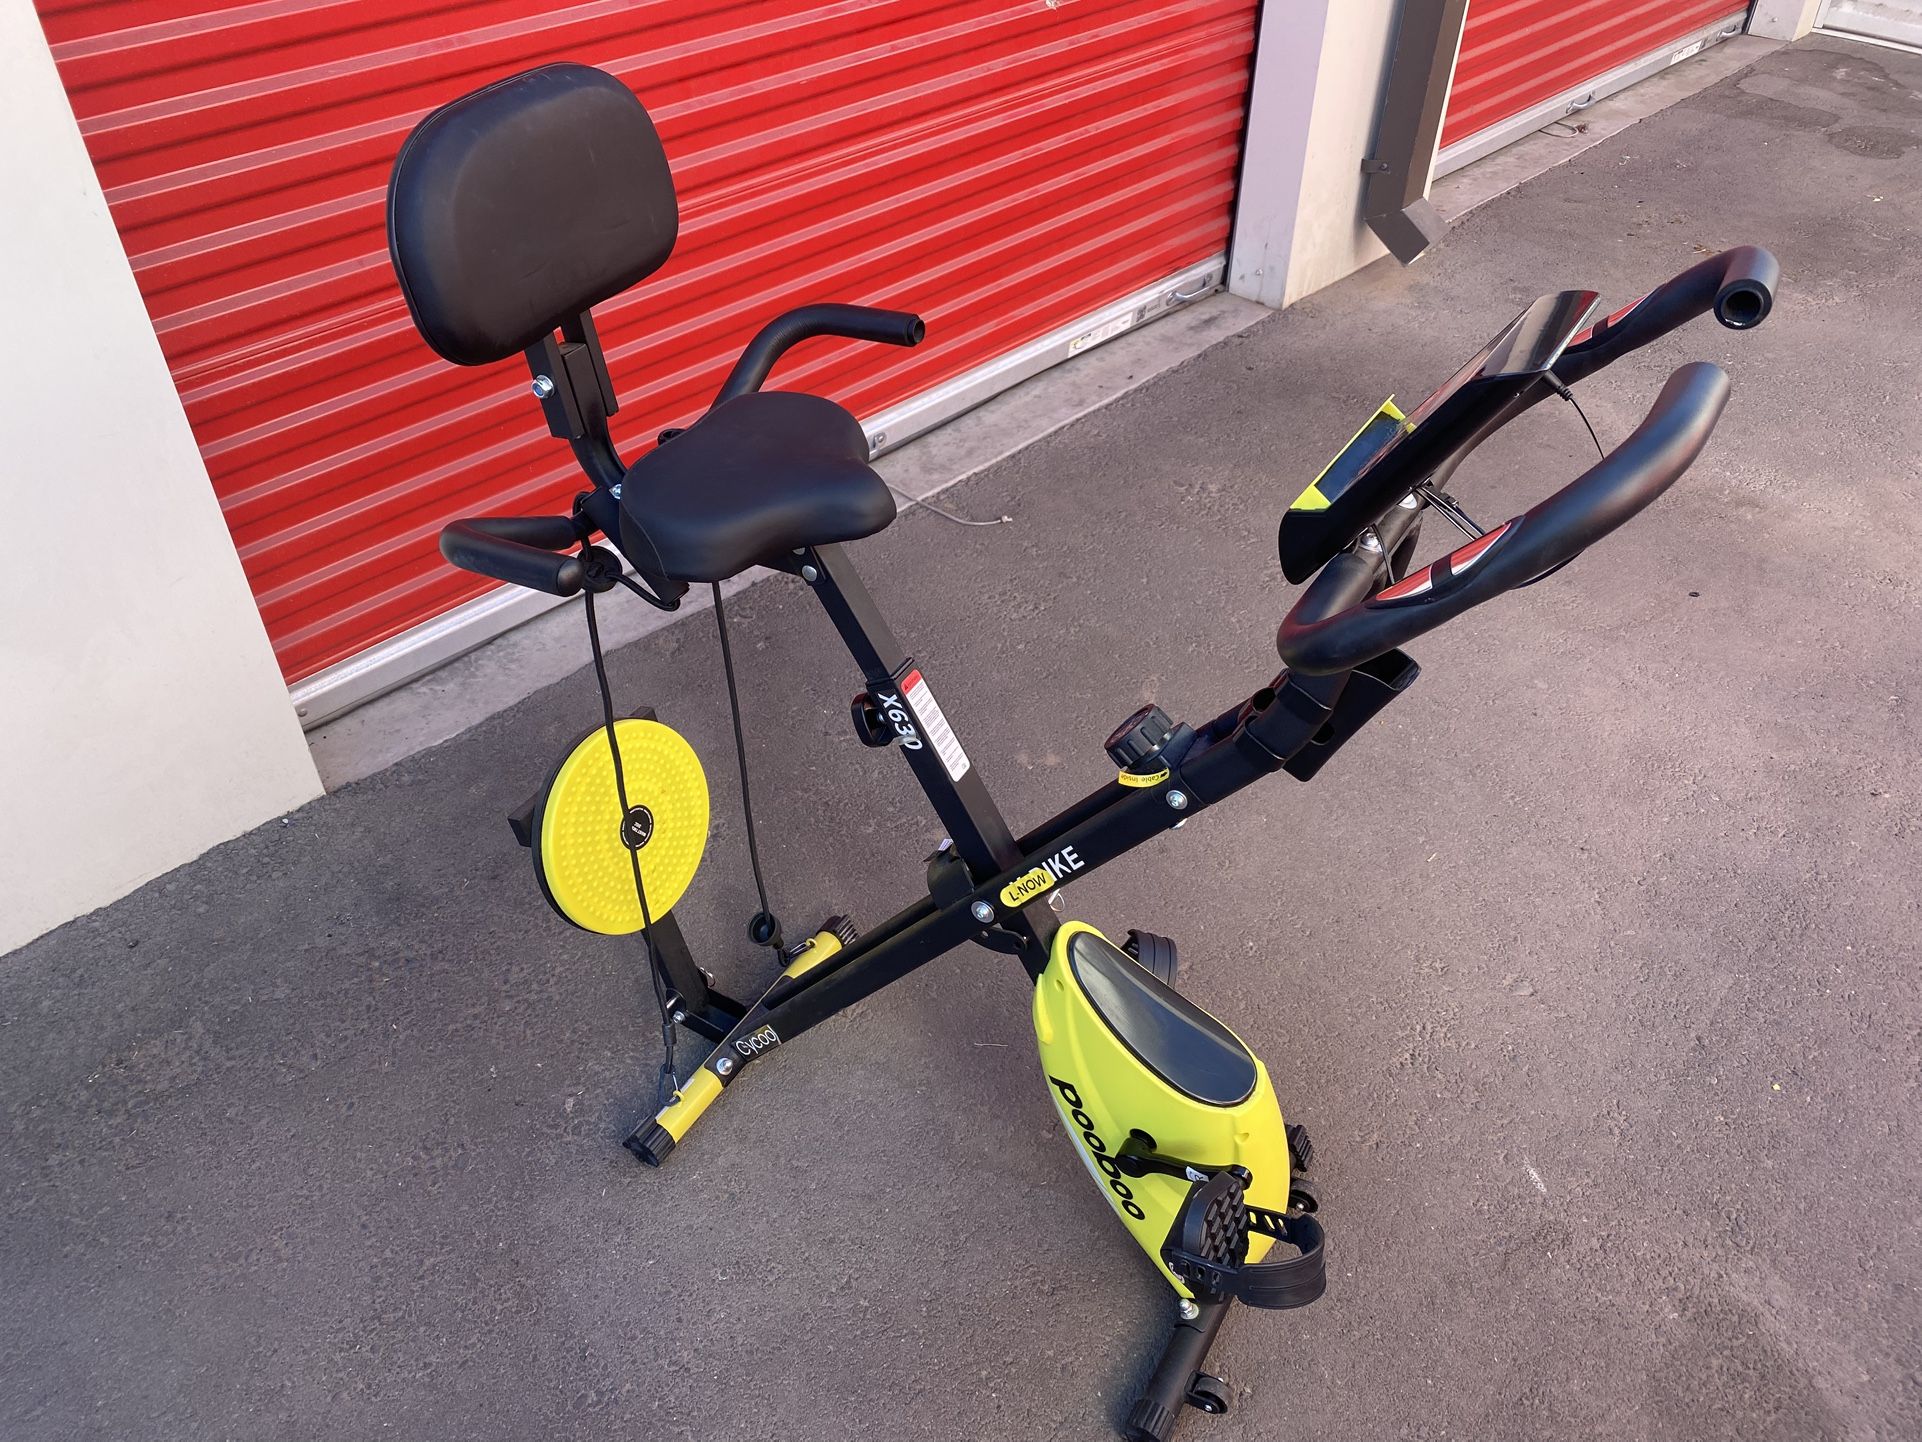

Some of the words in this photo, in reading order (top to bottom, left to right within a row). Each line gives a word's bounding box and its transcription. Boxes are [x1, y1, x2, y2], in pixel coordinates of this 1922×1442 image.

[878, 693, 923, 750] X630
[1008, 872, 1047, 902] L-NOW
[1048, 1075, 1146, 1221] pooboo
